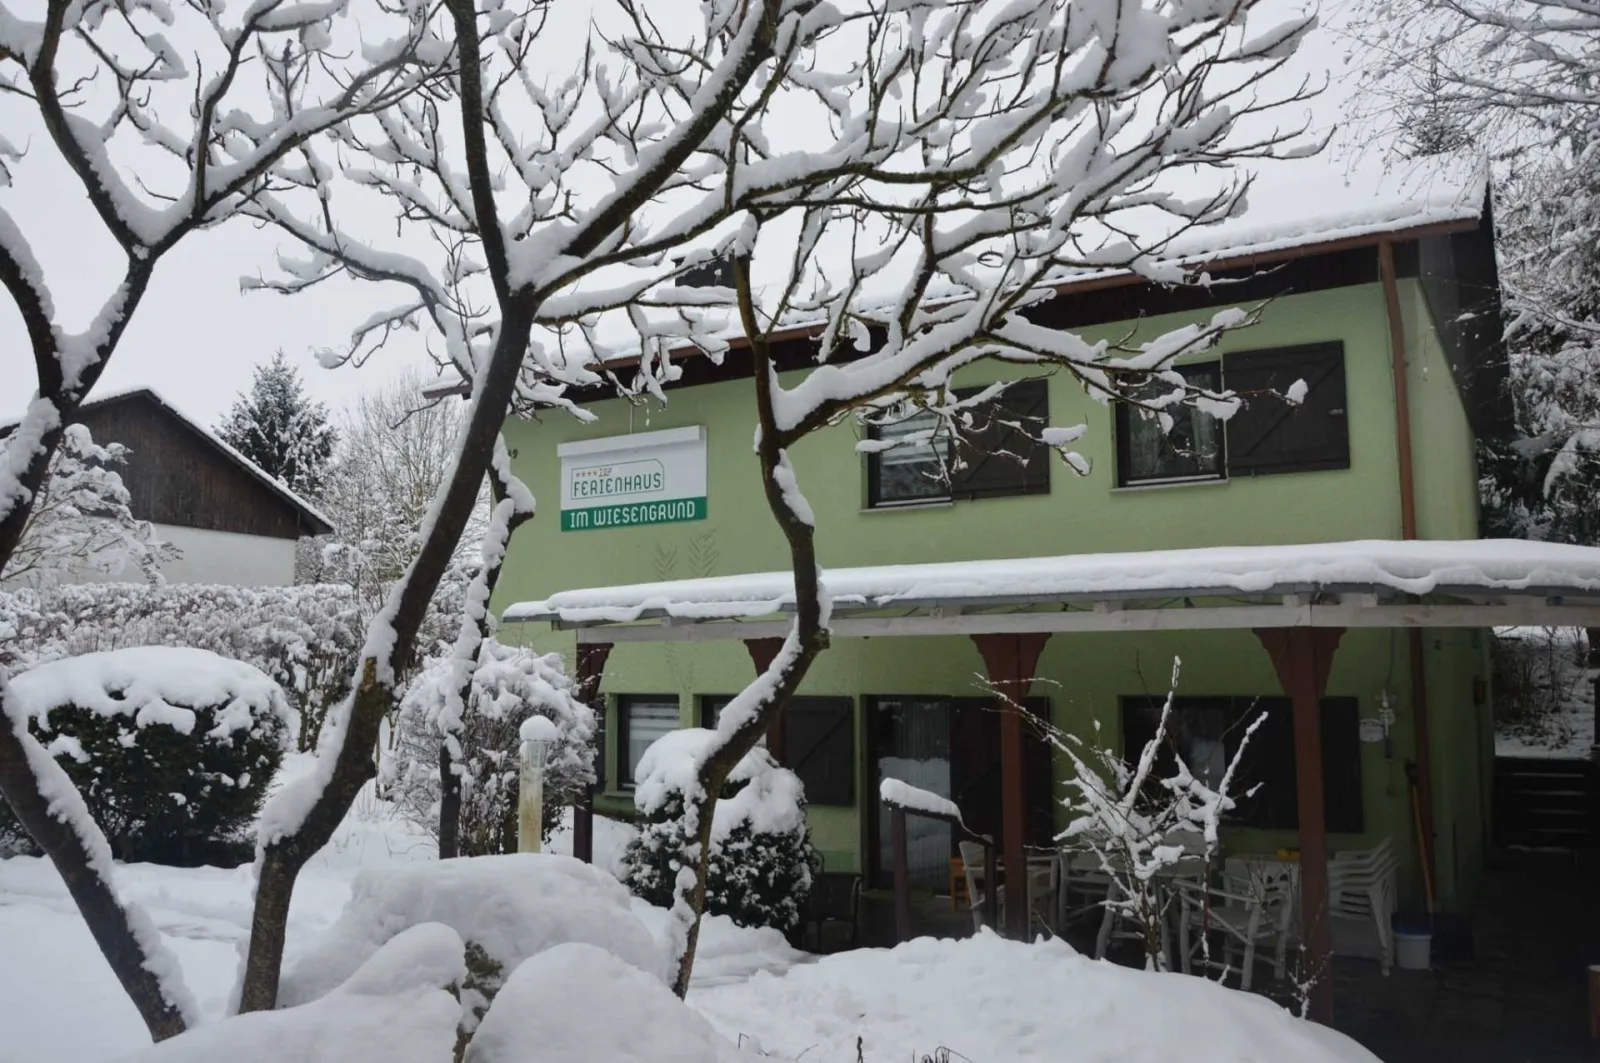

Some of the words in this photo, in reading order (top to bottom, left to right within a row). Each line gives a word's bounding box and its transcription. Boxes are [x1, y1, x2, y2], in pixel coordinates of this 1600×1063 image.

[573, 472, 662, 498] FERIENHAUS
[569, 511, 588, 528] IM
[593, 500, 696, 526] WIESENGRUND
